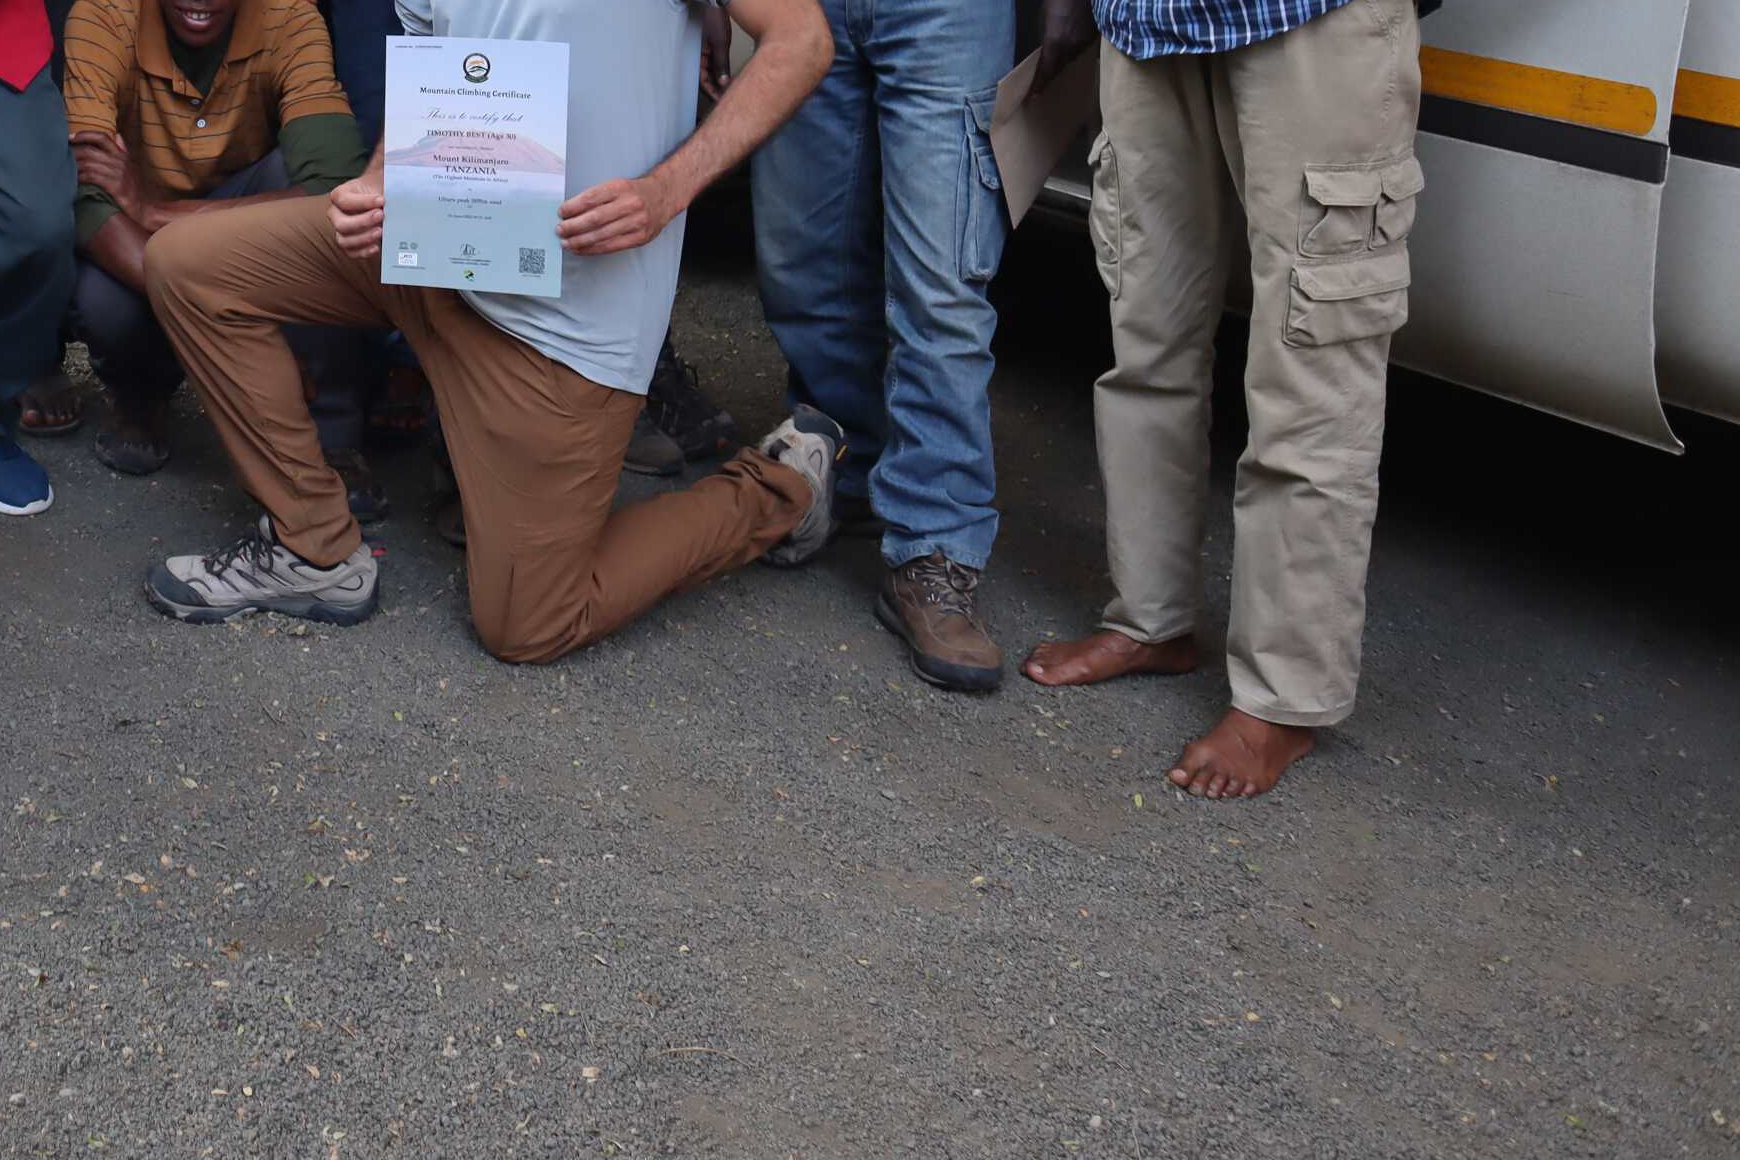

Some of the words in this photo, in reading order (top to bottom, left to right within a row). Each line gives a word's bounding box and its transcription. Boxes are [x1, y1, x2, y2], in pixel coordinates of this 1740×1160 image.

[420, 87, 456, 95] Mountain
[457, 88, 491, 98] Climbing
[492, 90, 531, 99] Certificate
[433, 155, 459, 163] Mount
[462, 156, 509, 166] Kilimanjaro
[445, 165, 497, 175] TANZANIA
